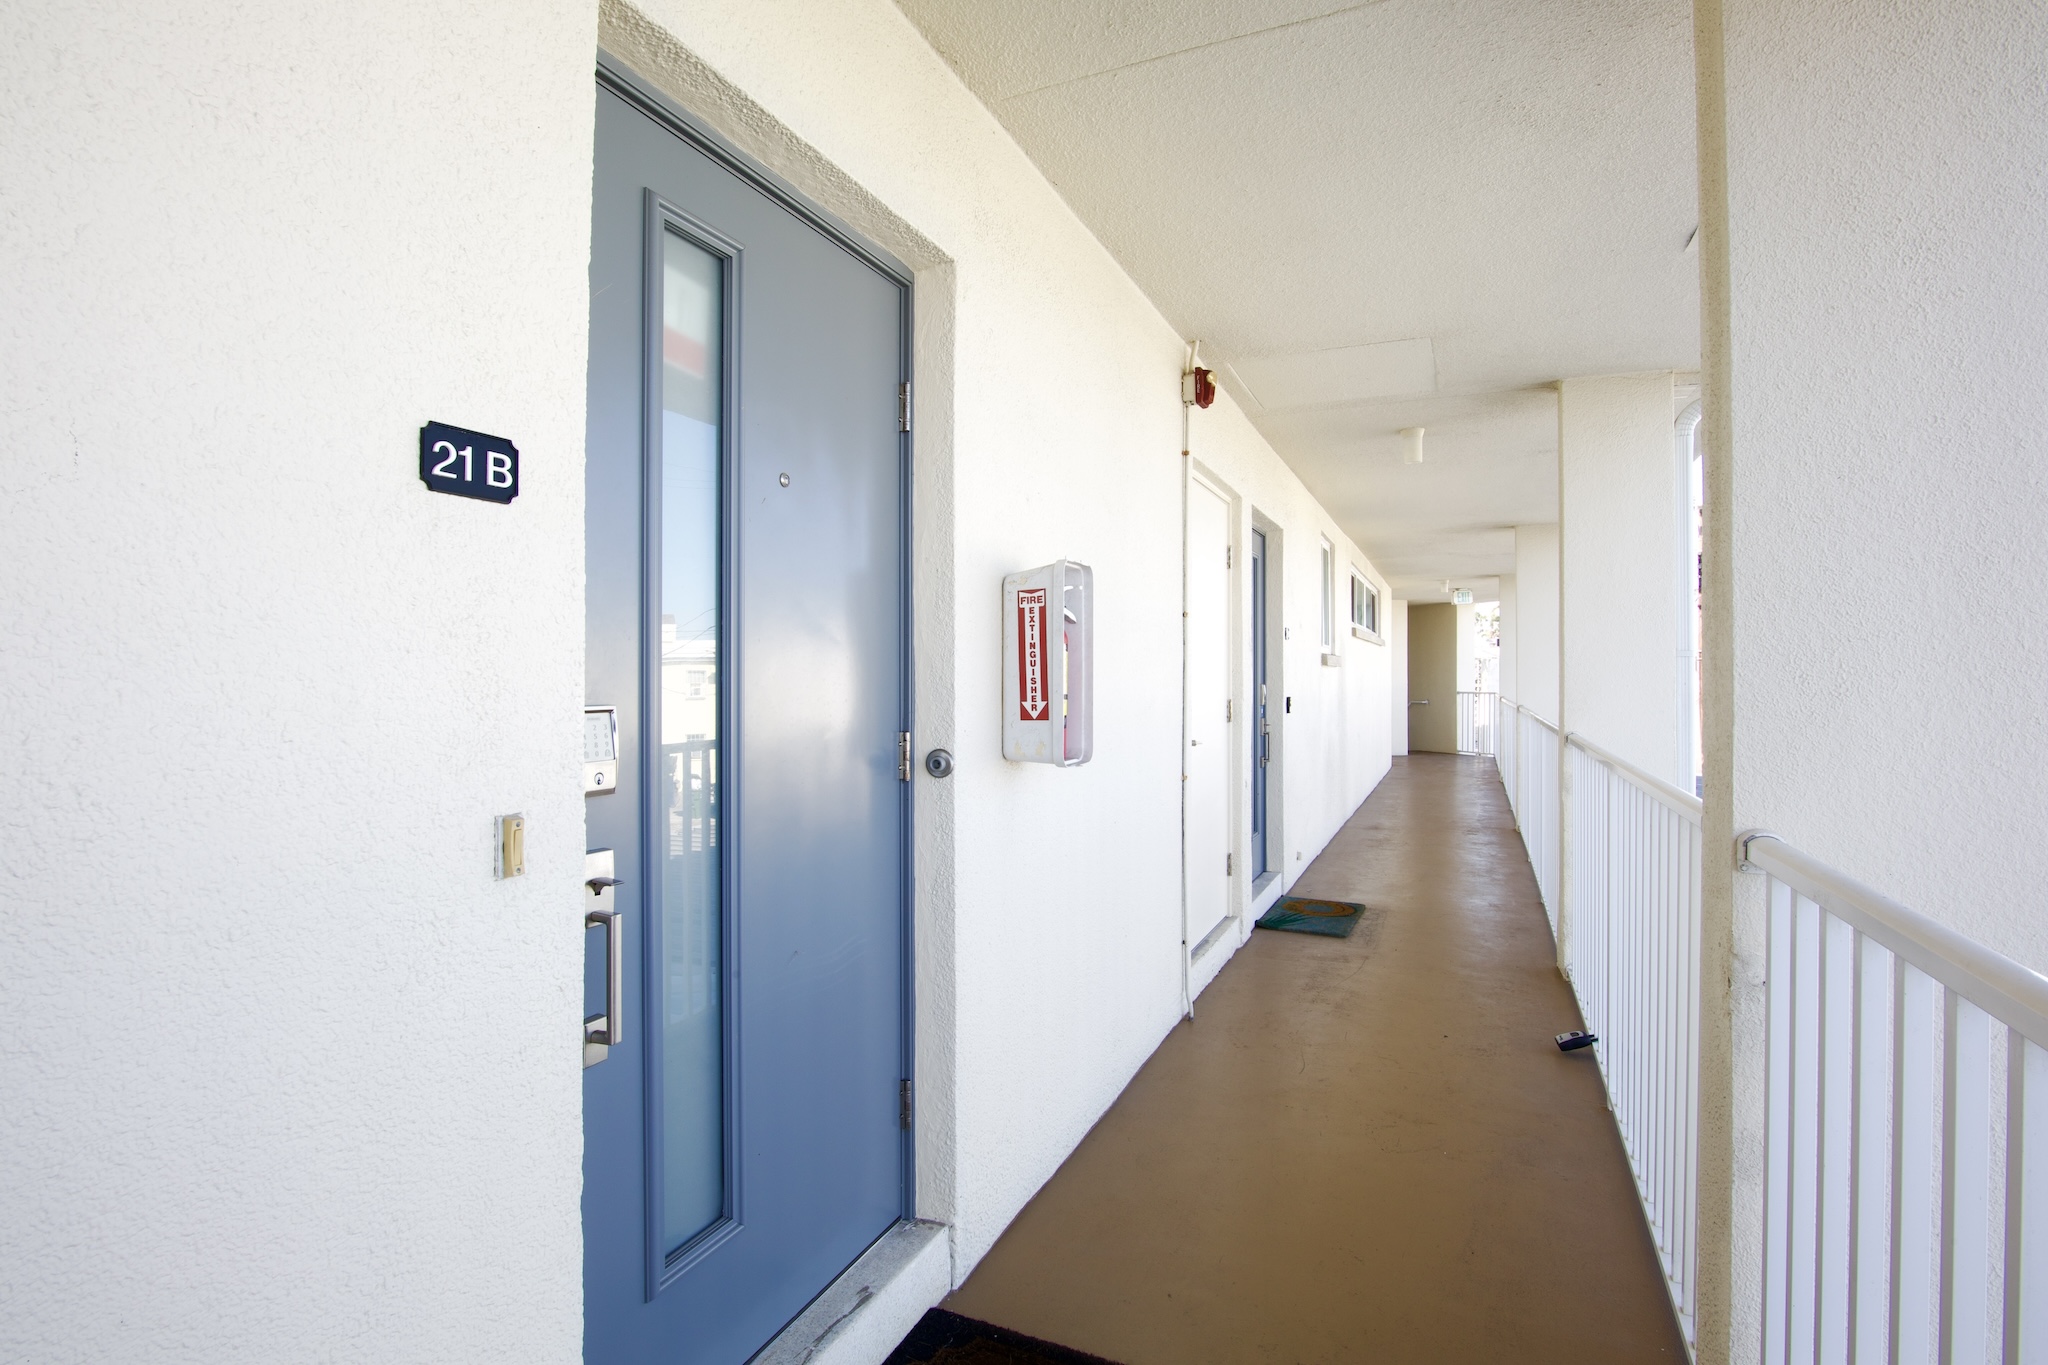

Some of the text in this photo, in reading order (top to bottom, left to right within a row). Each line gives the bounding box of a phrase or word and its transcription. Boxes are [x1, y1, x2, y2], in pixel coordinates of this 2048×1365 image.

[431, 440, 513, 488] 21 B
[1020, 595, 1043, 605] FIRE
[1029, 606, 1038, 712] EXTINGUISHER
